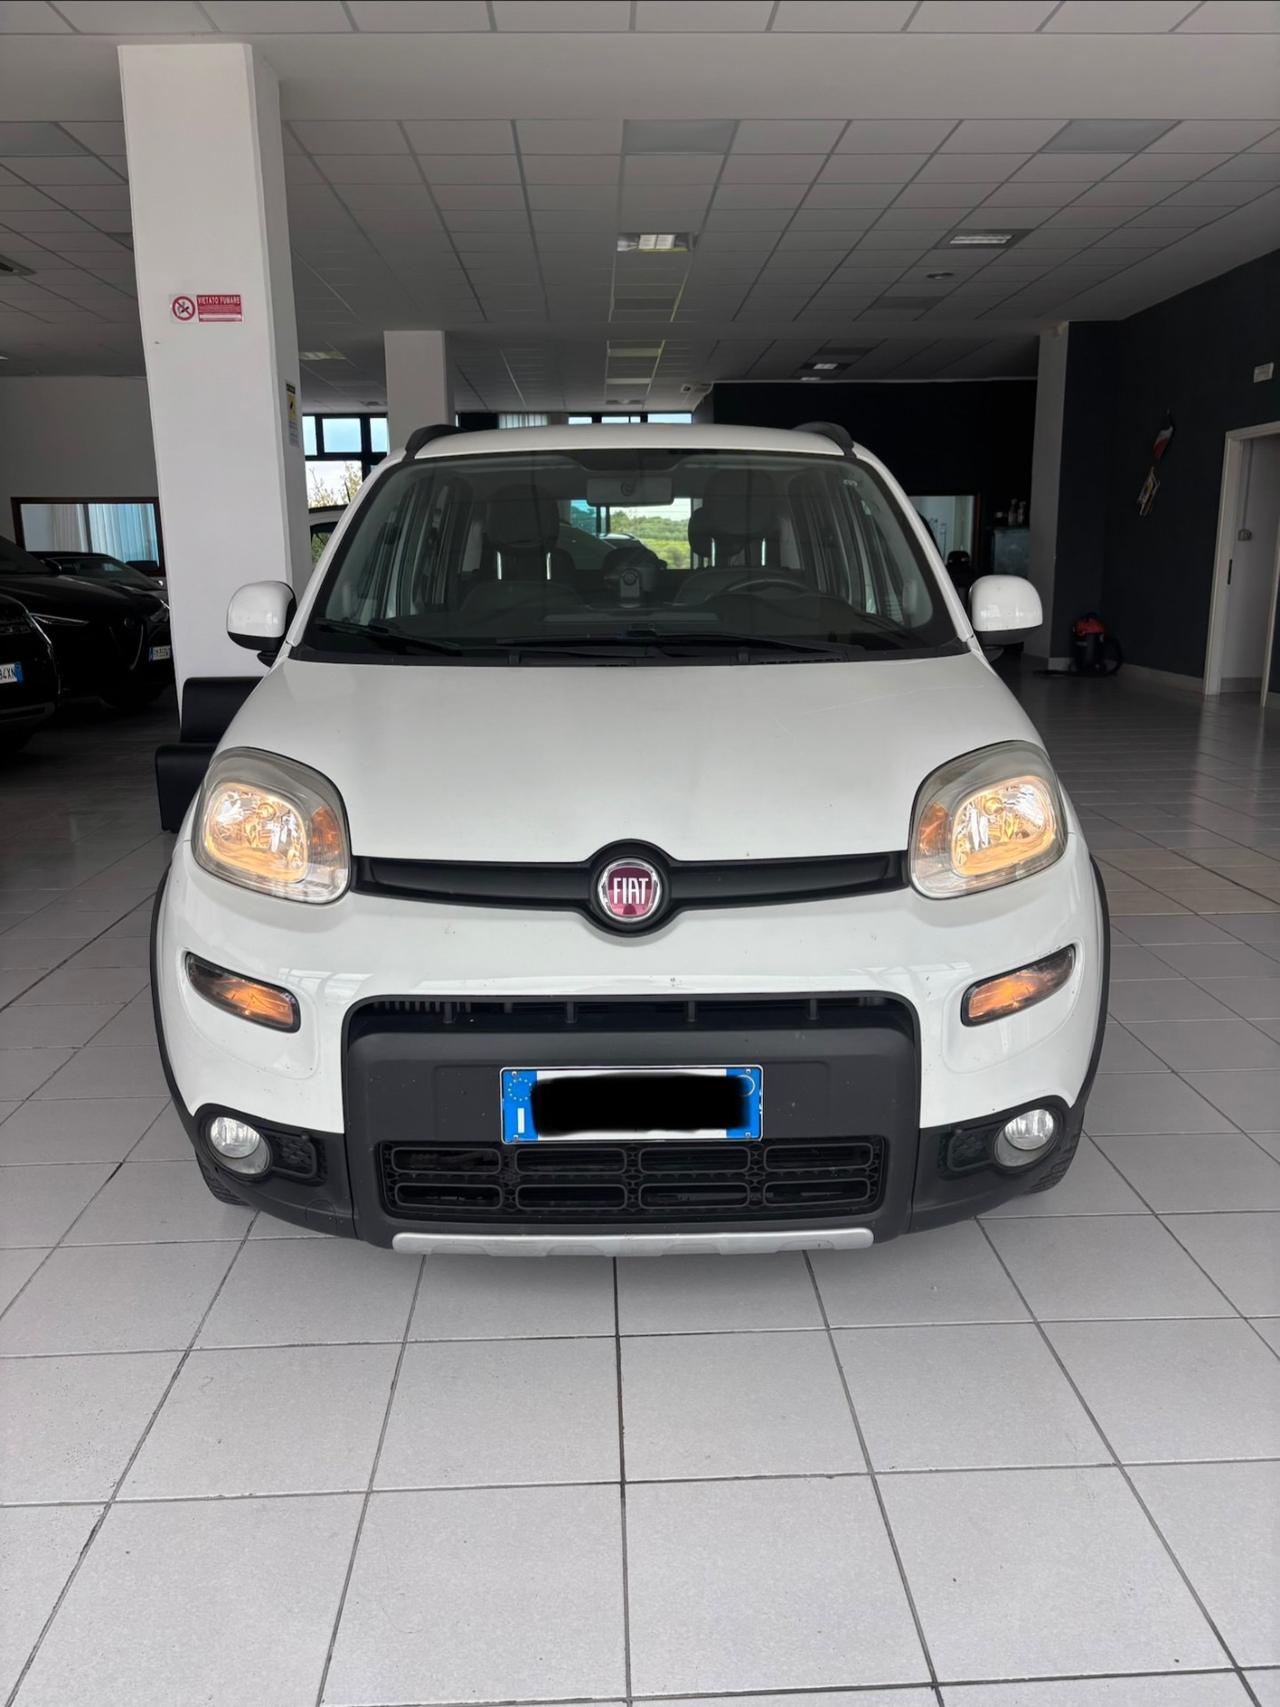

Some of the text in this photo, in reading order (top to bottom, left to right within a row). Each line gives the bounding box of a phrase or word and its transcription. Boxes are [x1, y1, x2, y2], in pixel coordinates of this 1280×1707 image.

[198, 296, 241, 305] VIETATO FUMARE
[613, 877, 649, 905] FIAT
